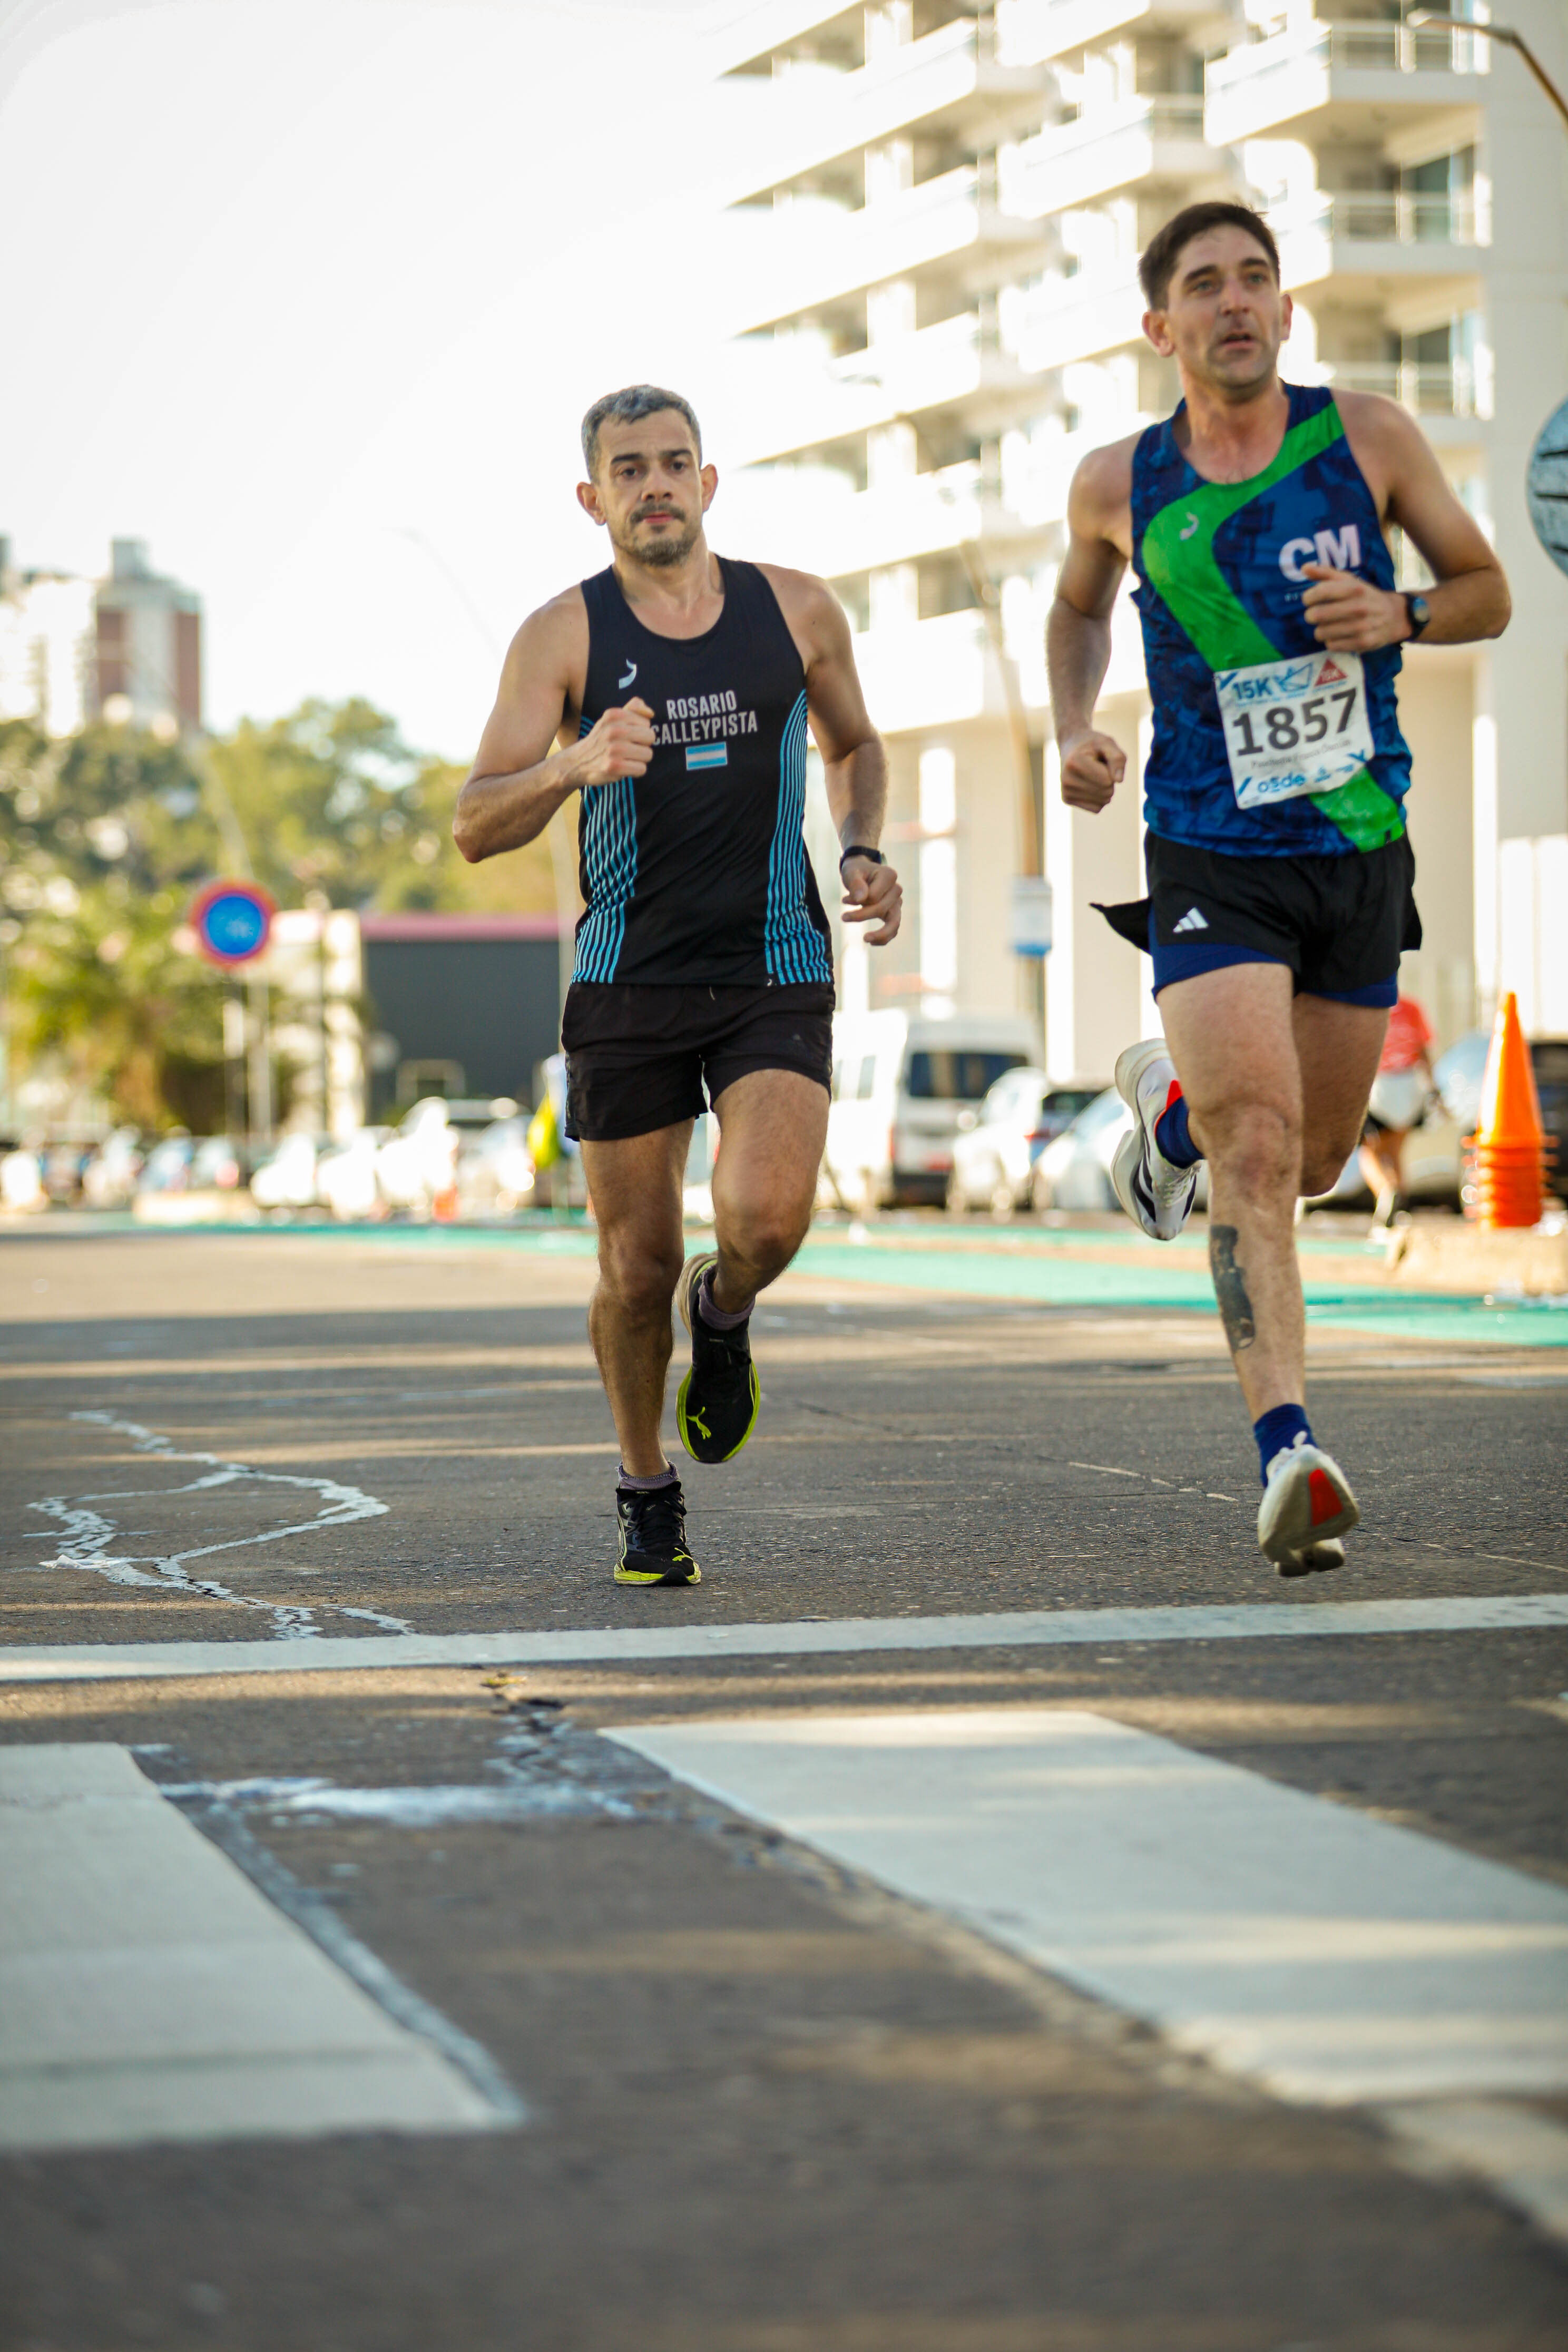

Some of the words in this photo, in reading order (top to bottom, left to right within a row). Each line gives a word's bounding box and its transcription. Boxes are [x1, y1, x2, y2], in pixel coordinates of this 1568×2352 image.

[1279, 524, 1360, 582] CM
[666, 690, 737, 720] ROSARIO
[1232, 677, 1273, 700] 15K
[1233, 687, 1357, 756] 1857
